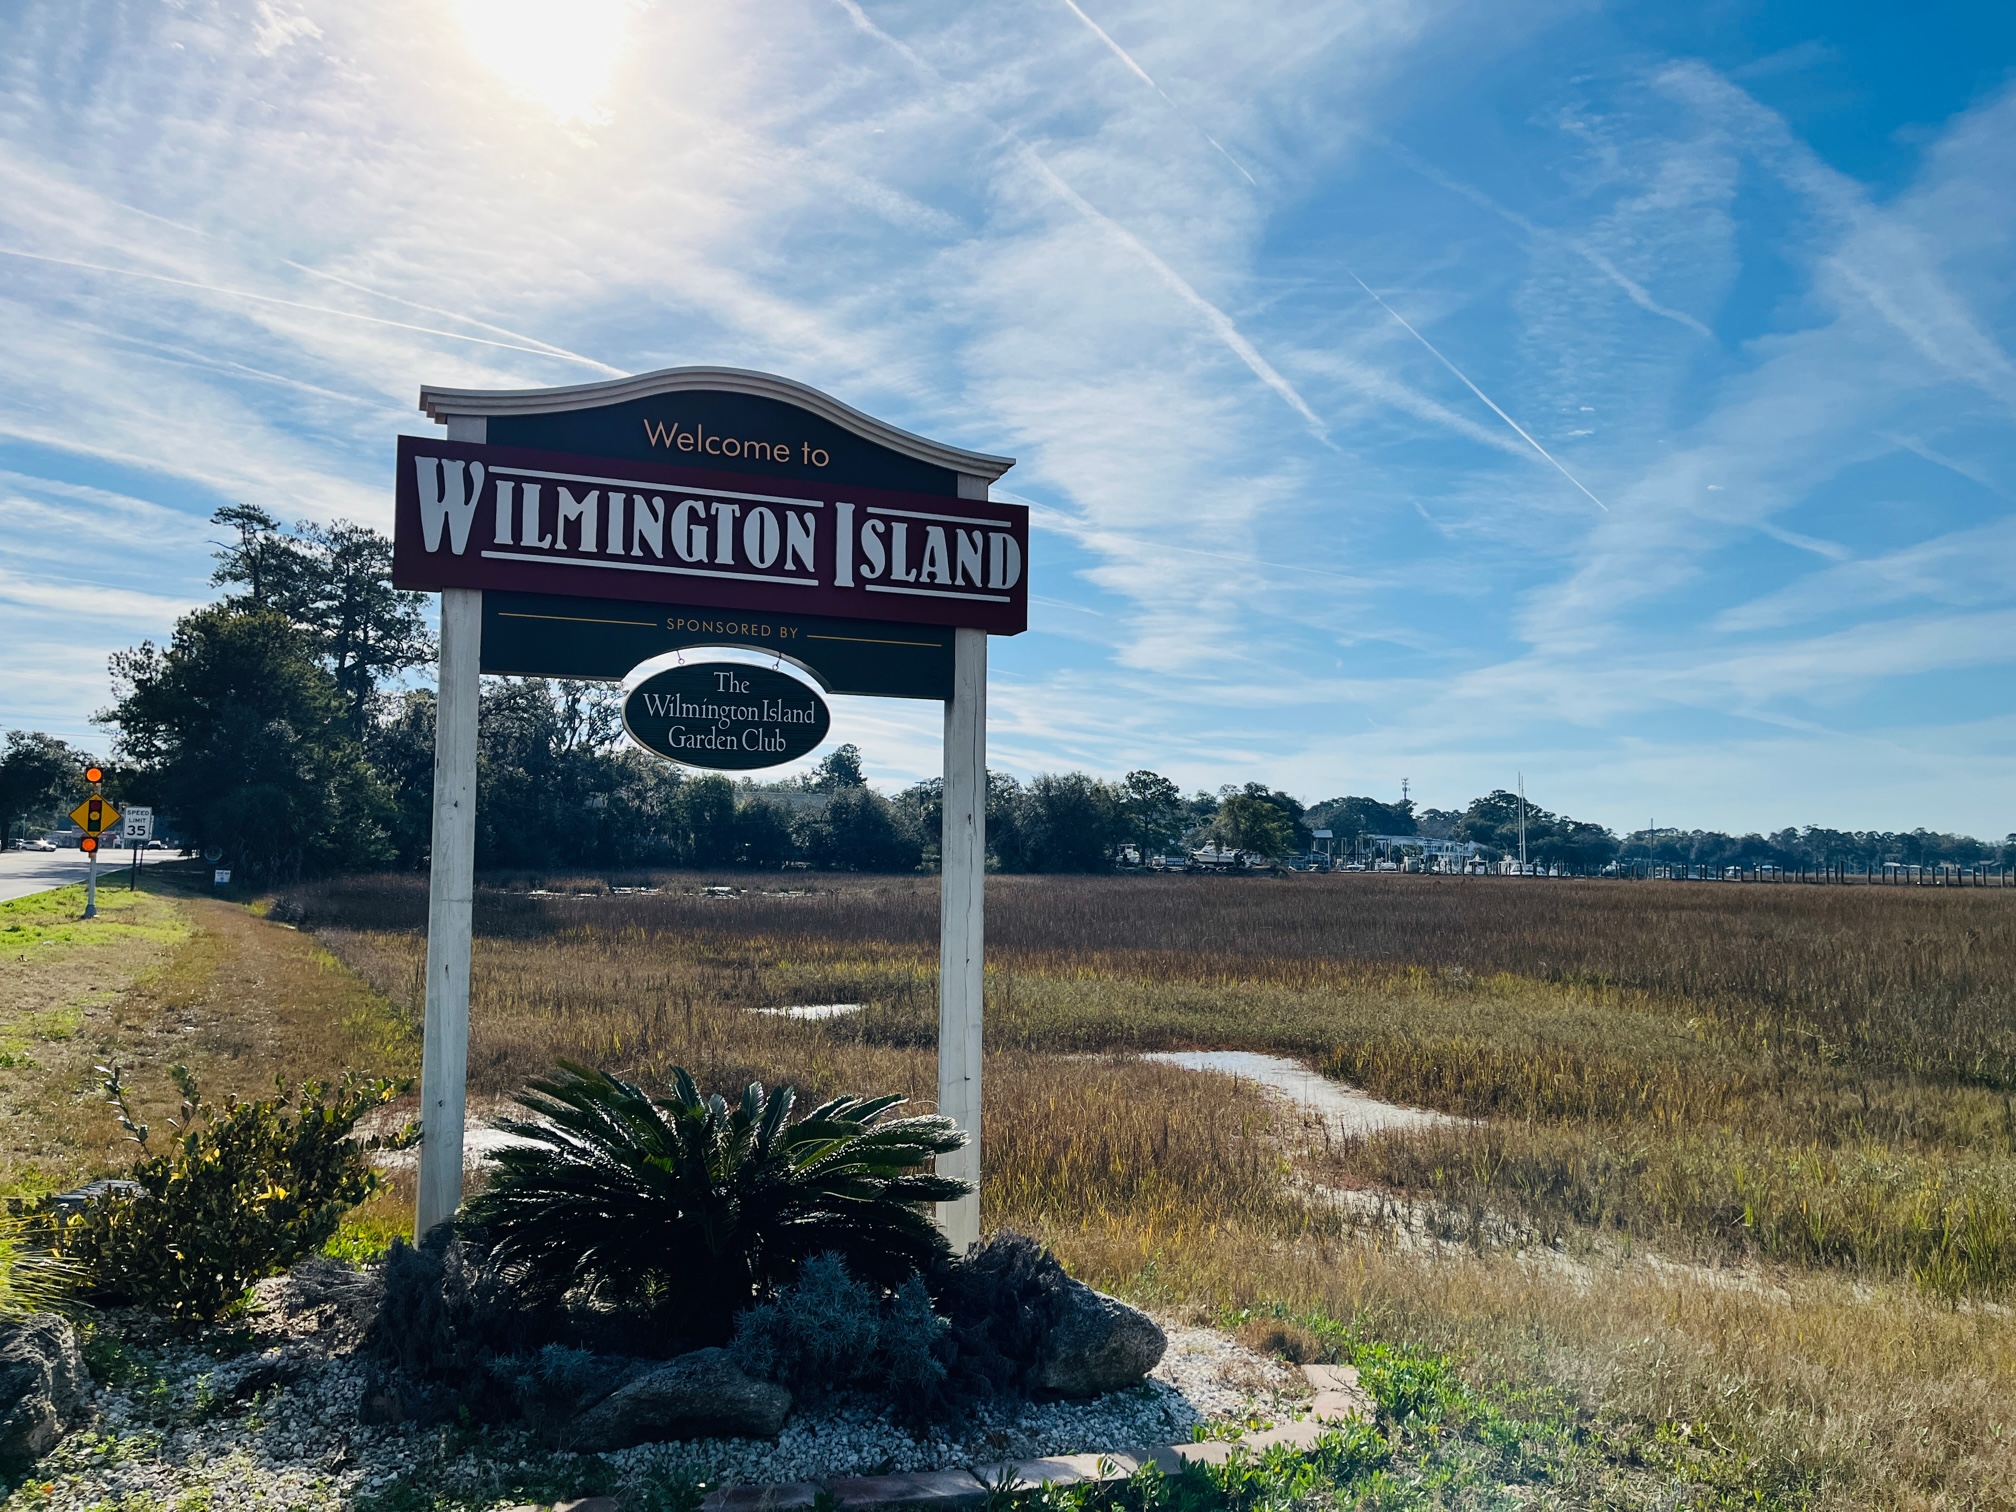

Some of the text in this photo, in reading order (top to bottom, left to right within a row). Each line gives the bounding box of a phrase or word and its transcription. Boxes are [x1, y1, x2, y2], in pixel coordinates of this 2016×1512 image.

[643, 418, 830, 467] Welcome to
[414, 455, 1022, 590] WILMINGTON ISLAND
[666, 617, 799, 639] SPONSORED BY
[713, 671, 750, 694] The
[643, 693, 816, 729] Wilmington Island
[668, 725, 787, 752] Garden Club
[126, 825, 146, 836] 35
